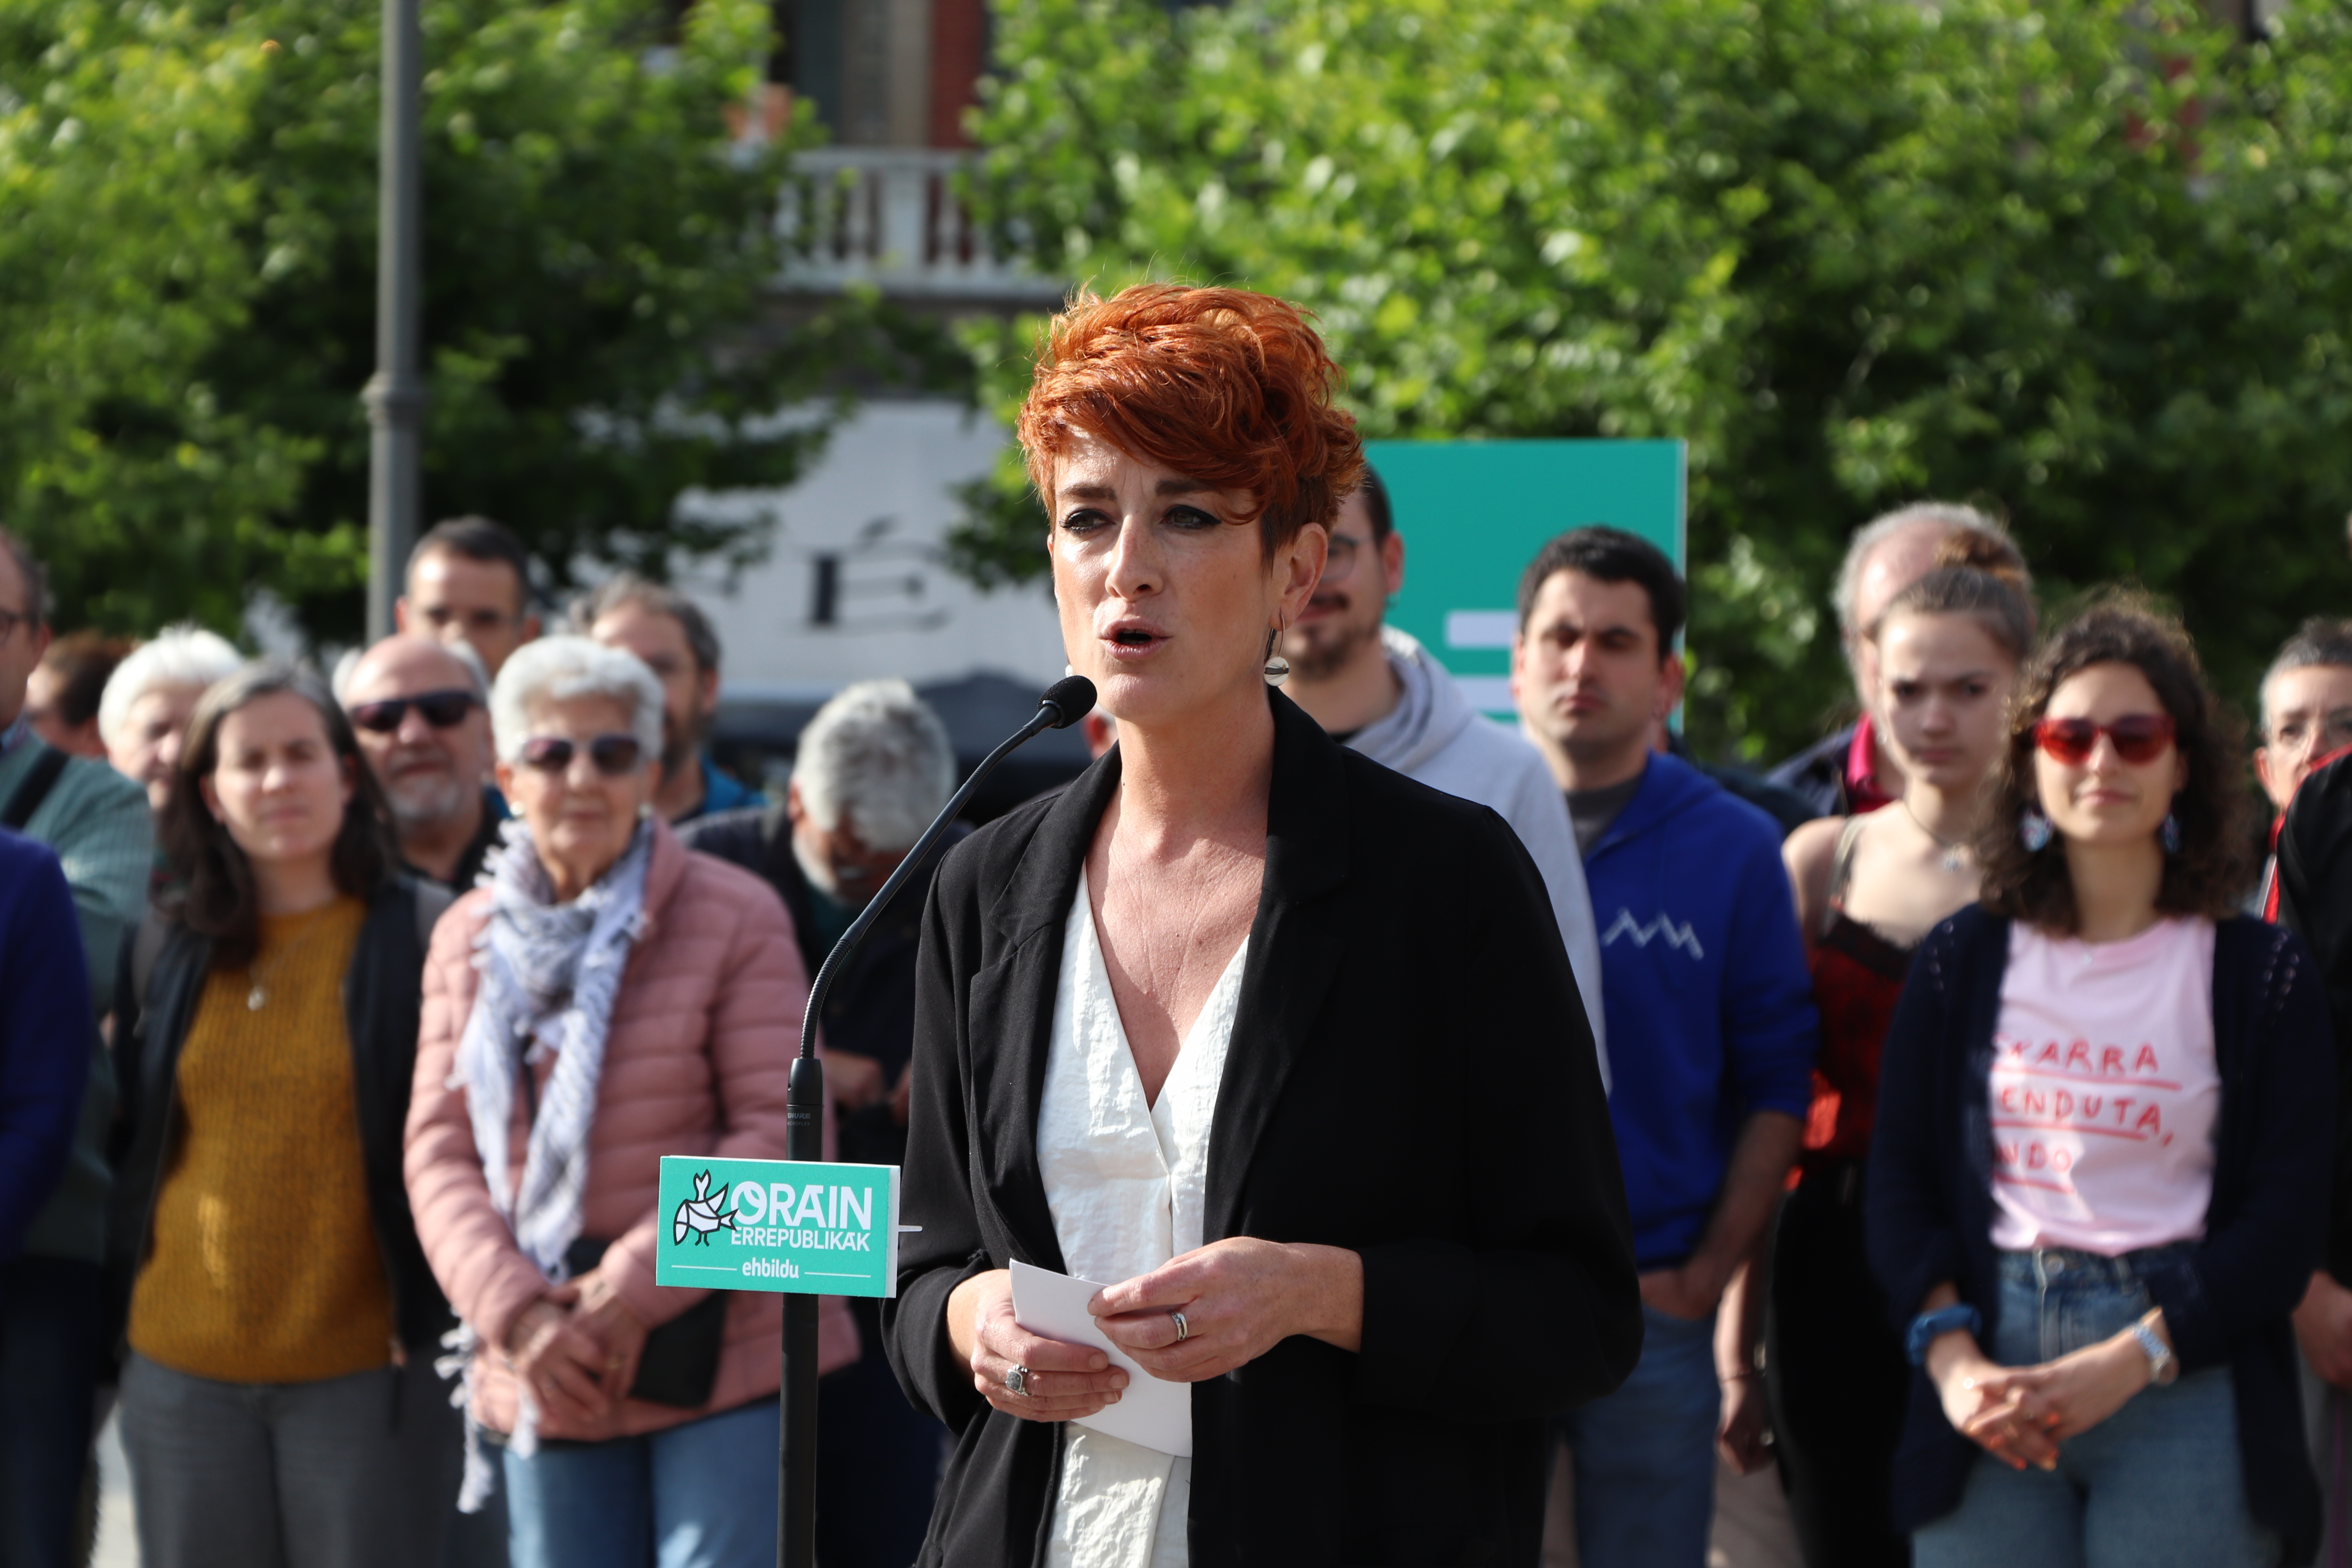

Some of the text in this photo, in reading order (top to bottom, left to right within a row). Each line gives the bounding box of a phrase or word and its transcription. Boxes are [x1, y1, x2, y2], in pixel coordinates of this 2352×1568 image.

[730, 1181, 872, 1230] ORAIN
[731, 1227, 870, 1251] ERREPUBLIKAK
[742, 1257, 799, 1278] ehbildu
